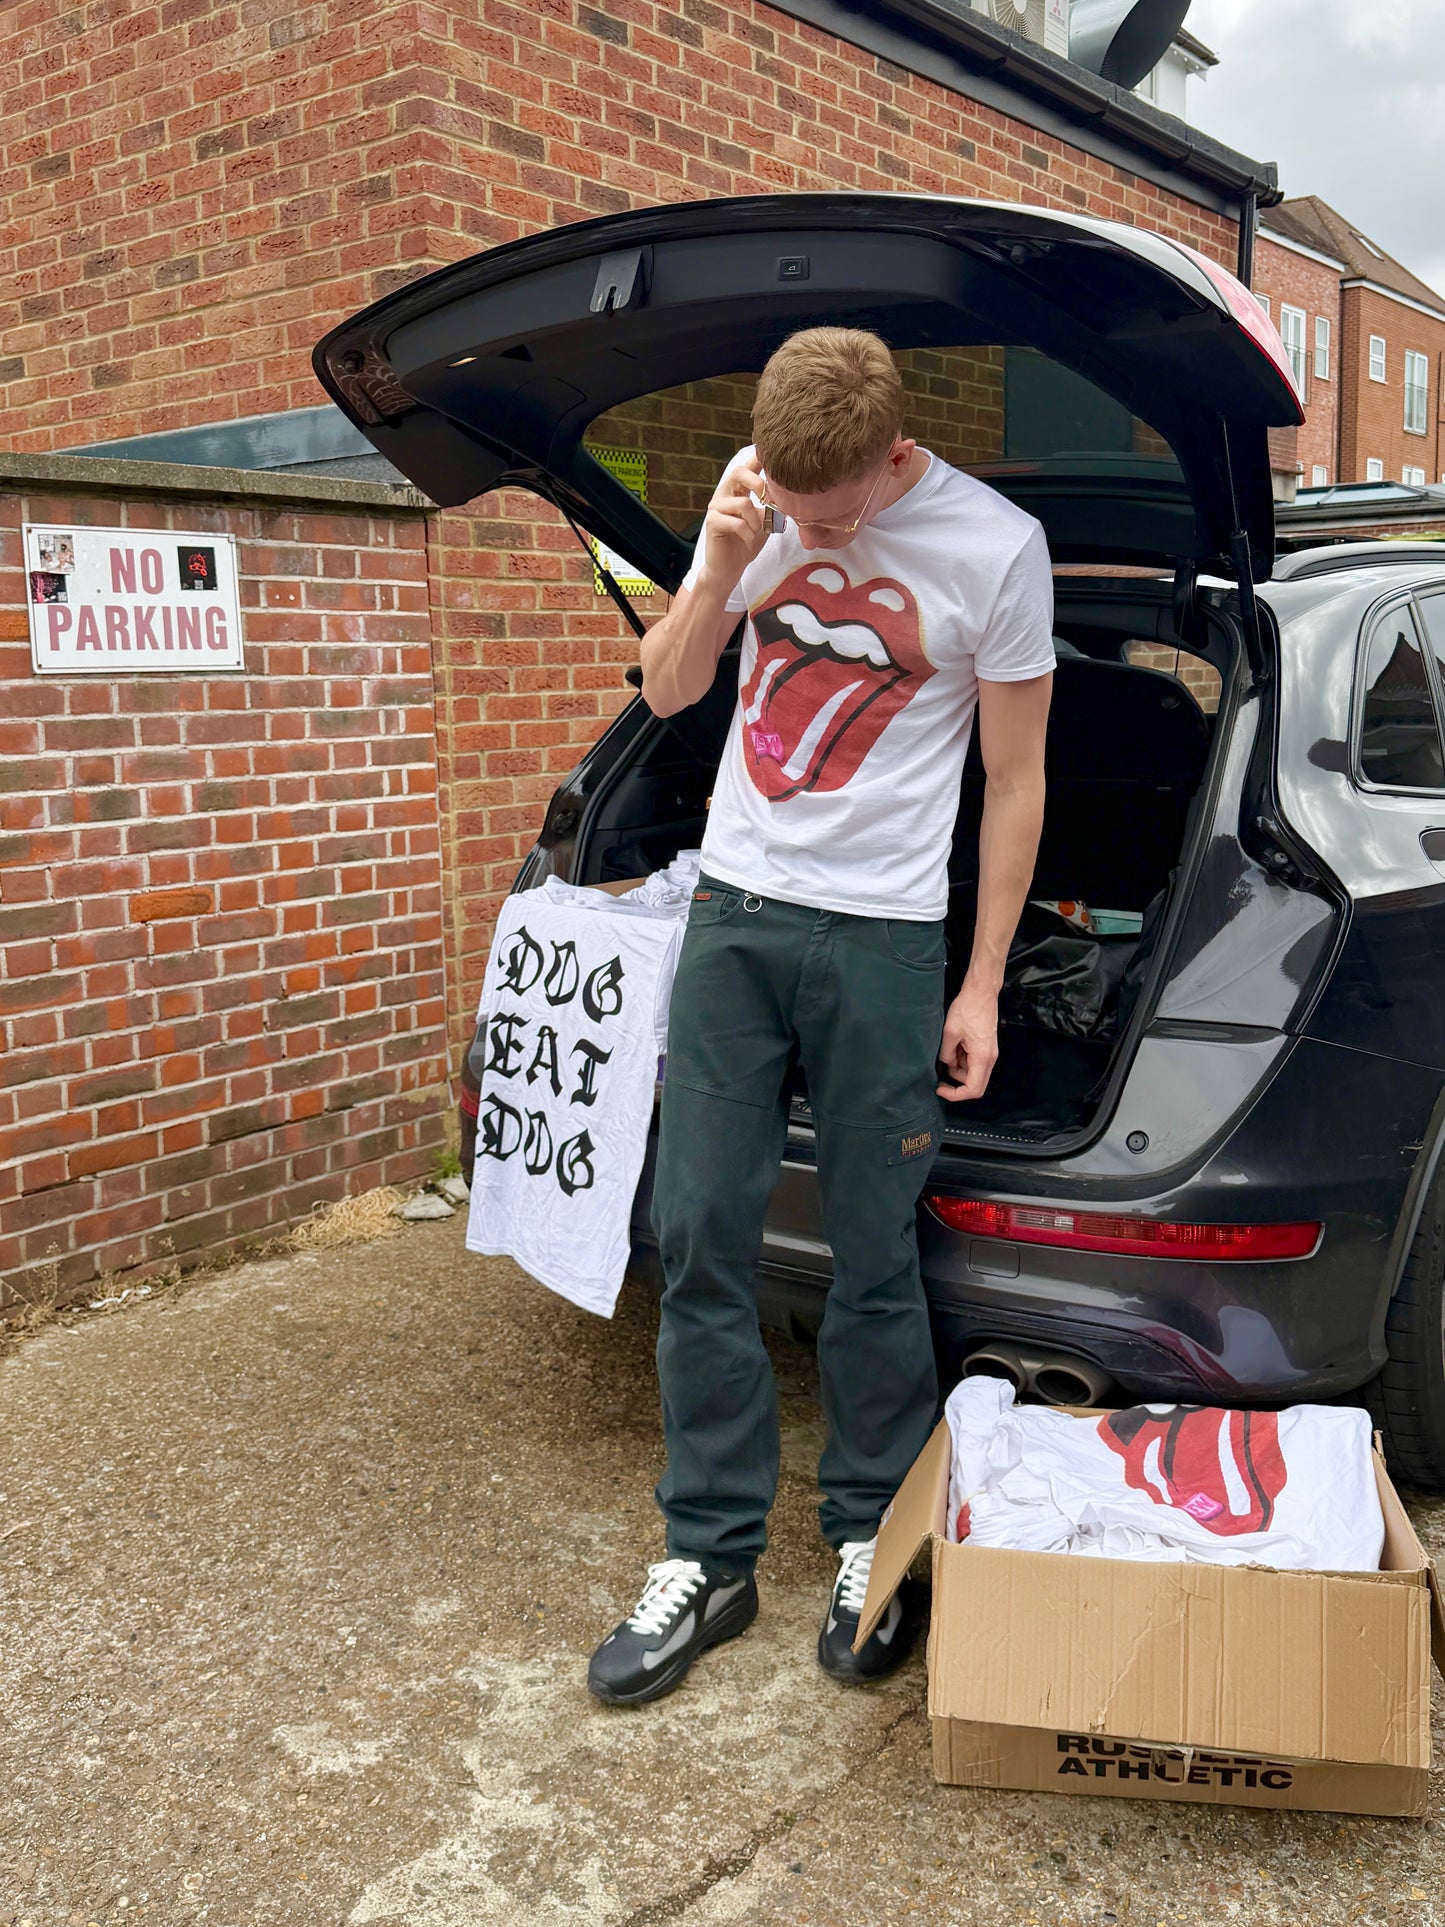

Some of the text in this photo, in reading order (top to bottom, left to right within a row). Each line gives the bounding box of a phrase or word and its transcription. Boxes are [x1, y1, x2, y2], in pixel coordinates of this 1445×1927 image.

[109, 547, 165, 595] NO
[47, 604, 229, 651] PARKING
[496, 925, 626, 1024] DOG
[483, 1012, 615, 1107] EAT
[475, 1091, 596, 1198] DOG
[1057, 1757, 1293, 1790] ATHLETIC
